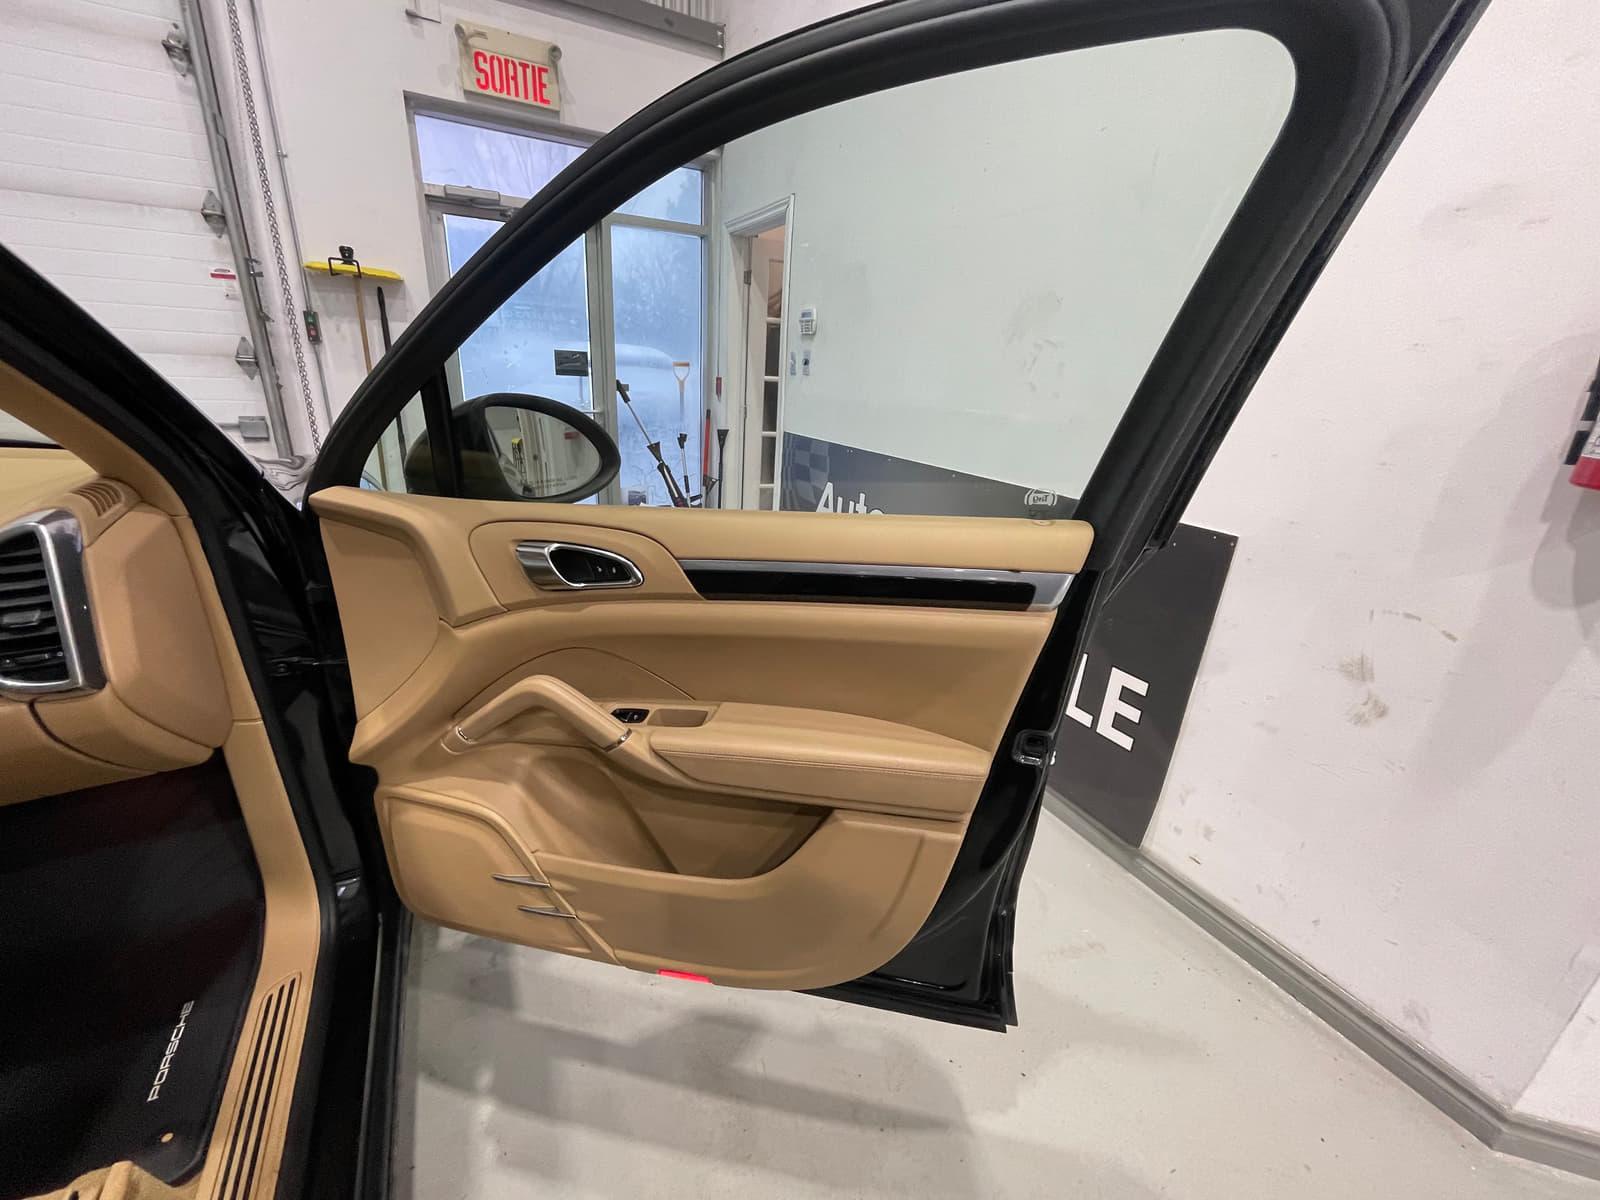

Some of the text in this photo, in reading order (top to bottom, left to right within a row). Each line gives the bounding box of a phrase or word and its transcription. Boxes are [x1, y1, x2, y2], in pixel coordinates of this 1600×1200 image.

[473, 51, 551, 105] SORTIE
[815, 482, 884, 516] Aut
[147, 1000, 195, 1102] PORSCHE
